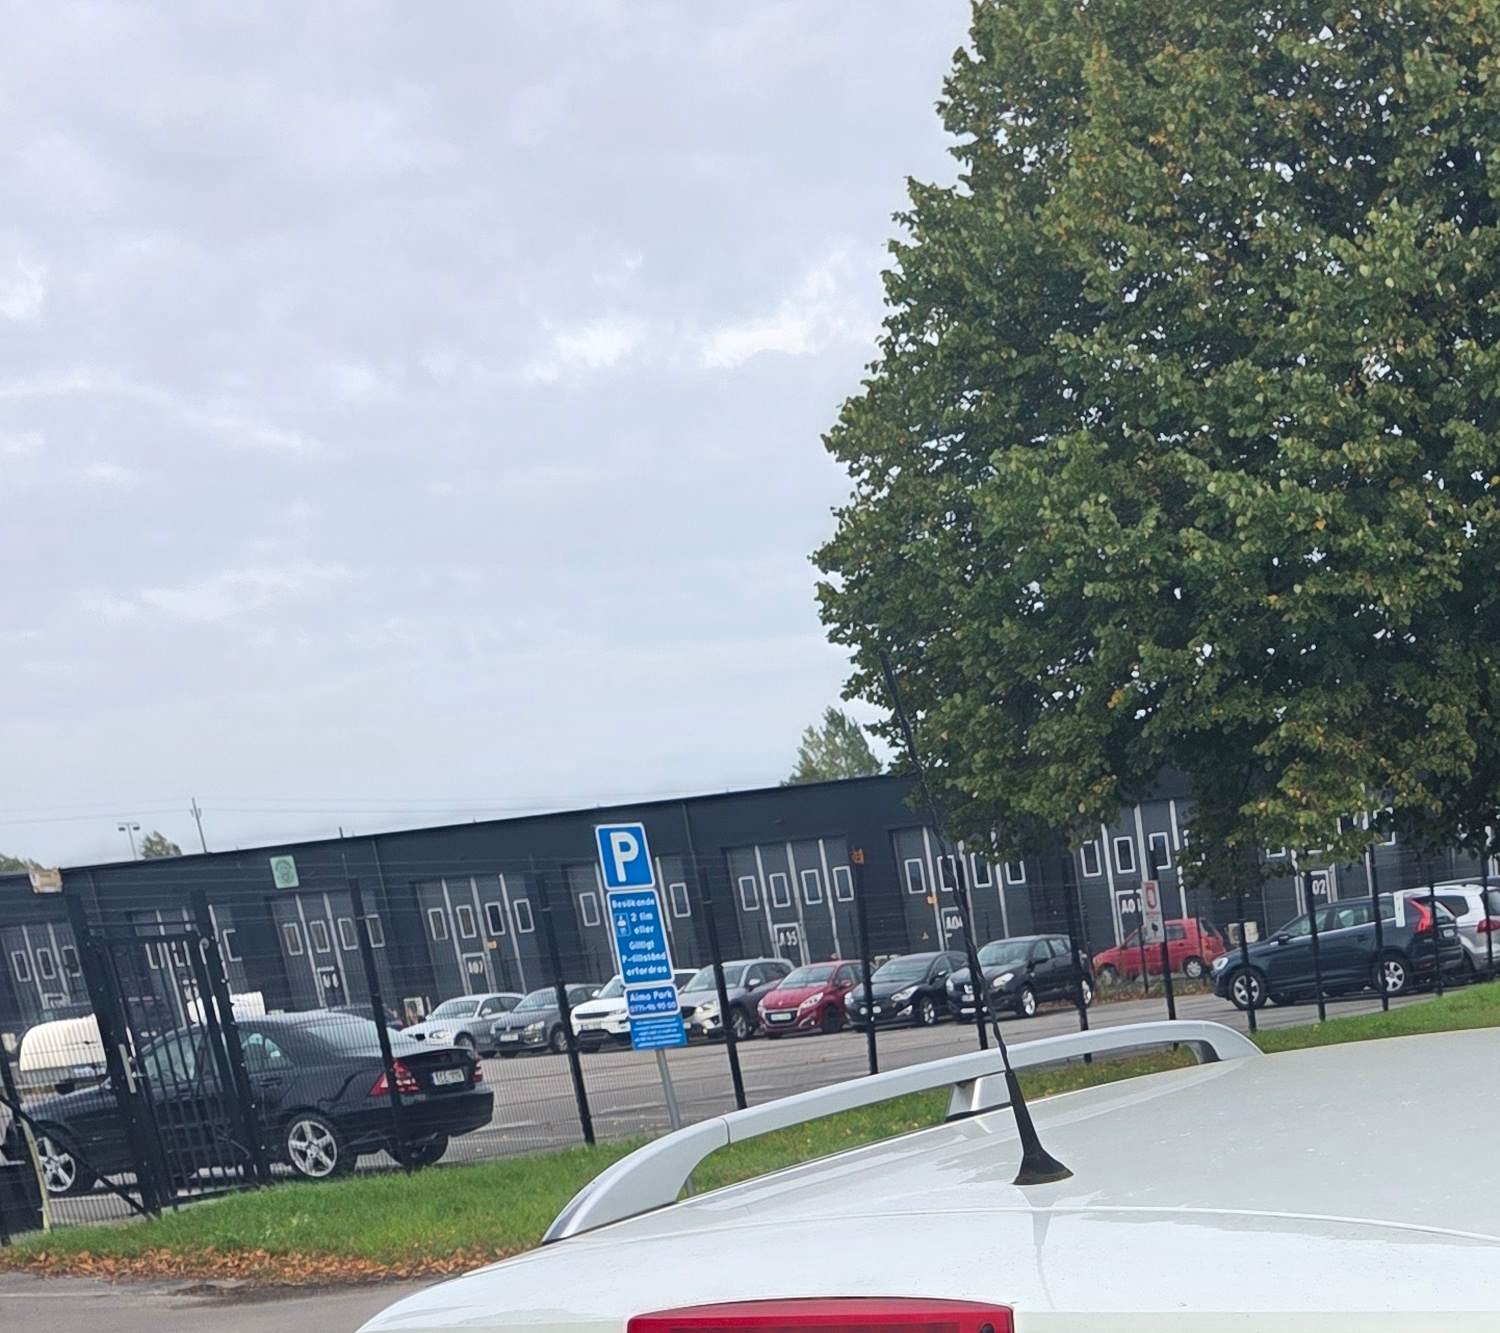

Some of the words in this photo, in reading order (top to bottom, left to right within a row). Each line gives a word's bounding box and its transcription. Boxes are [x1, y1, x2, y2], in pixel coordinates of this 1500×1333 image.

[610, 832, 639, 882] P
[612, 897, 655, 909] Besökande
[630, 912, 637, 922] 2
[639, 911, 653, 921] tim
[634, 925, 654, 935] eller
[630, 992, 652, 1002] Aimo
[653, 990, 673, 1000] Park
